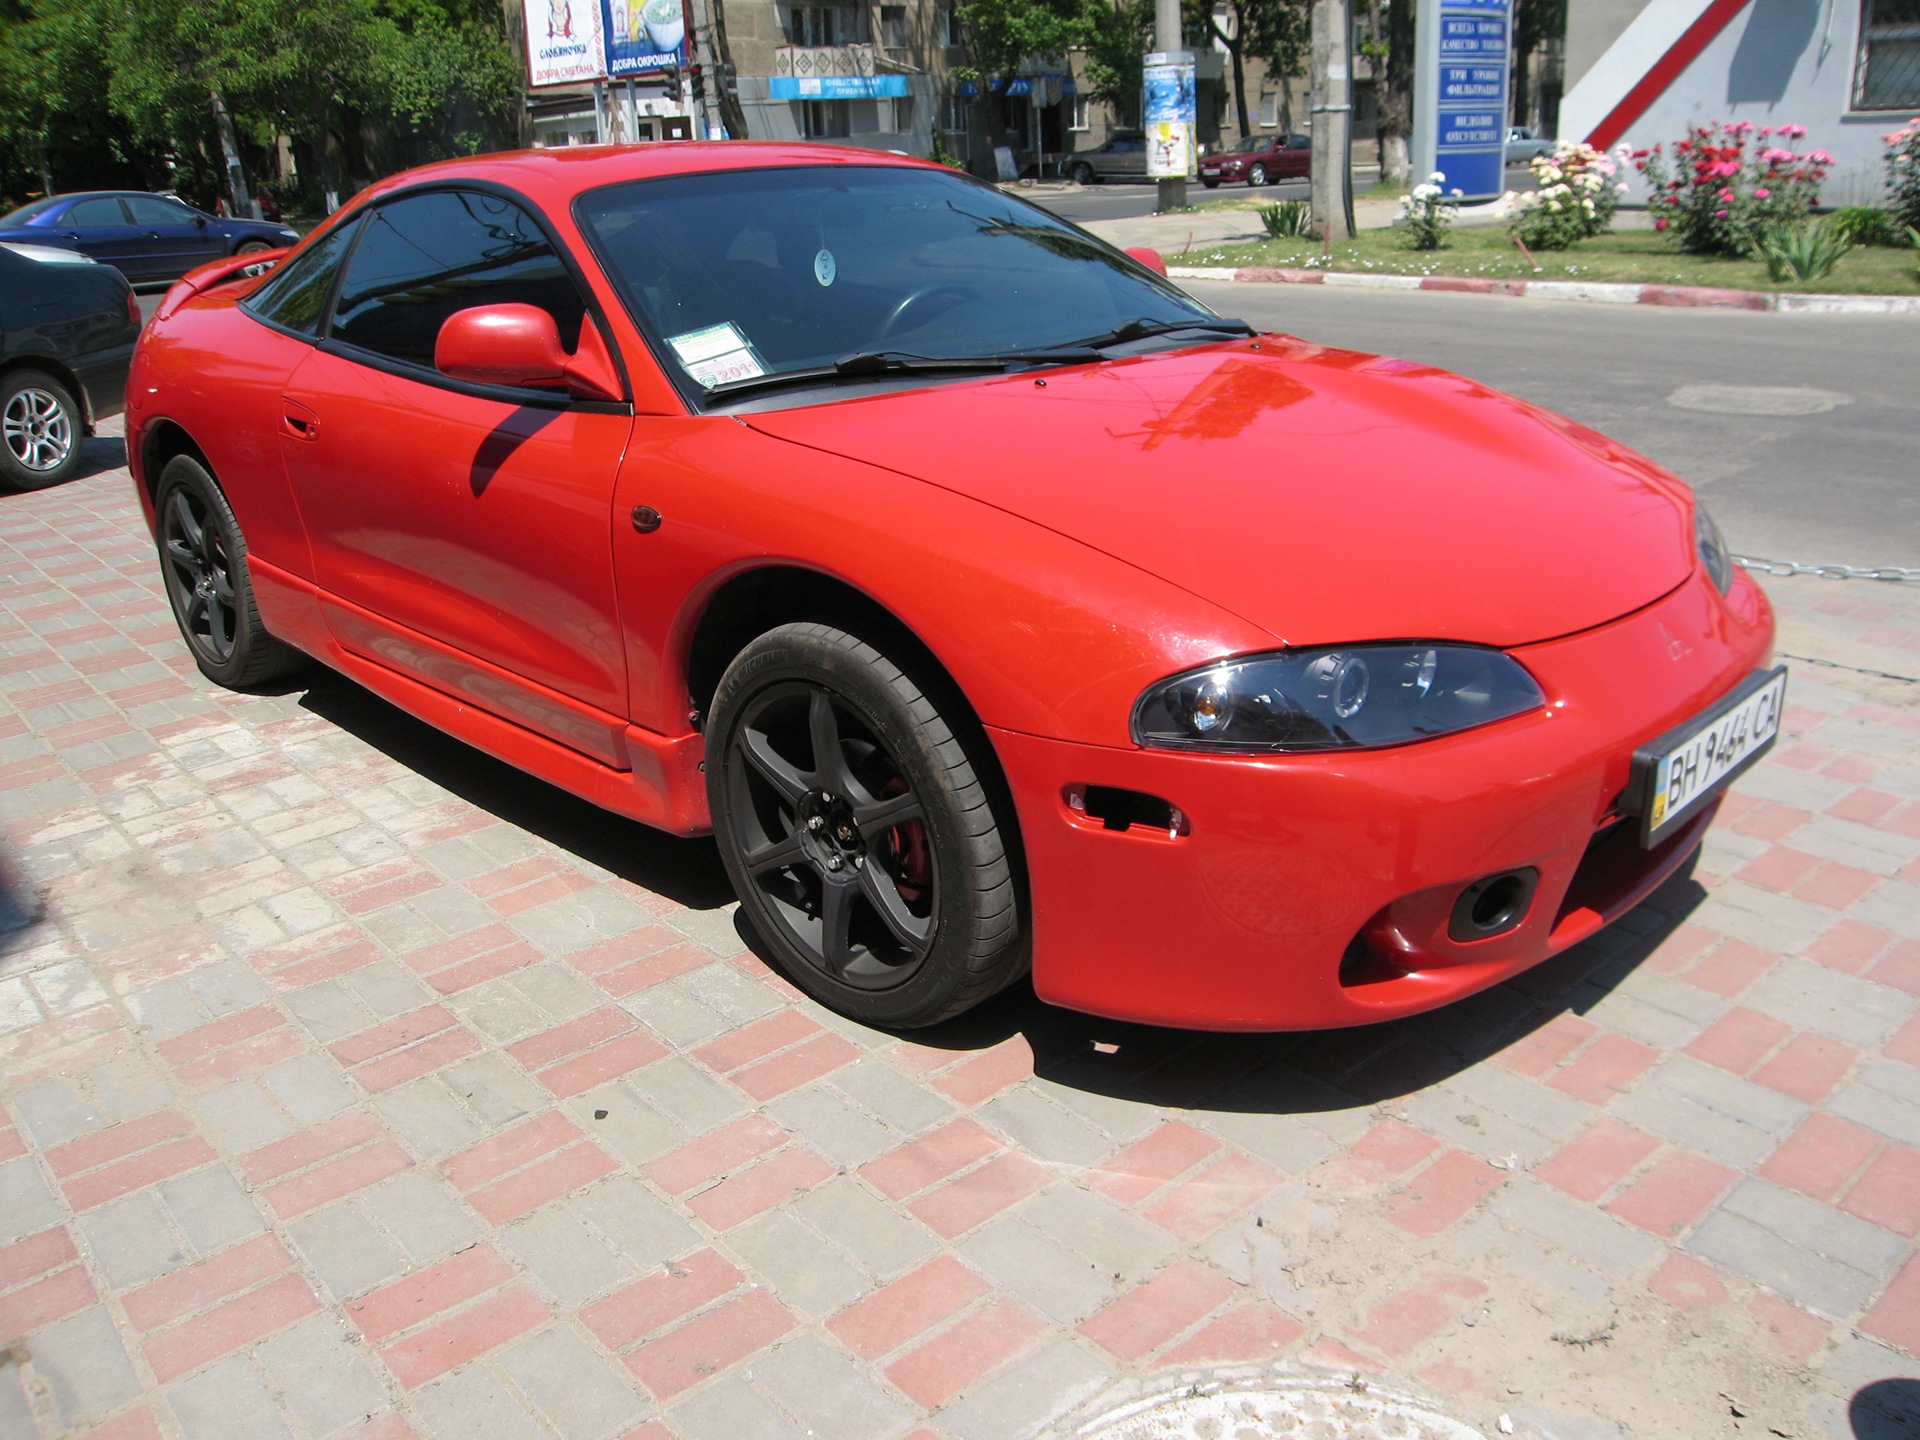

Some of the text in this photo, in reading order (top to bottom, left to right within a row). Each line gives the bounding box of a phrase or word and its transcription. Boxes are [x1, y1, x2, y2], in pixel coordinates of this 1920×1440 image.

[536, 64, 595, 81] ДОБРА СМЕТАНА
[612, 53, 677, 72] ДОБРА ОКРОШКА
[717, 360, 760, 381] 2011
[1668, 742, 1701, 810] BH
[1754, 685, 1778, 740] CA
